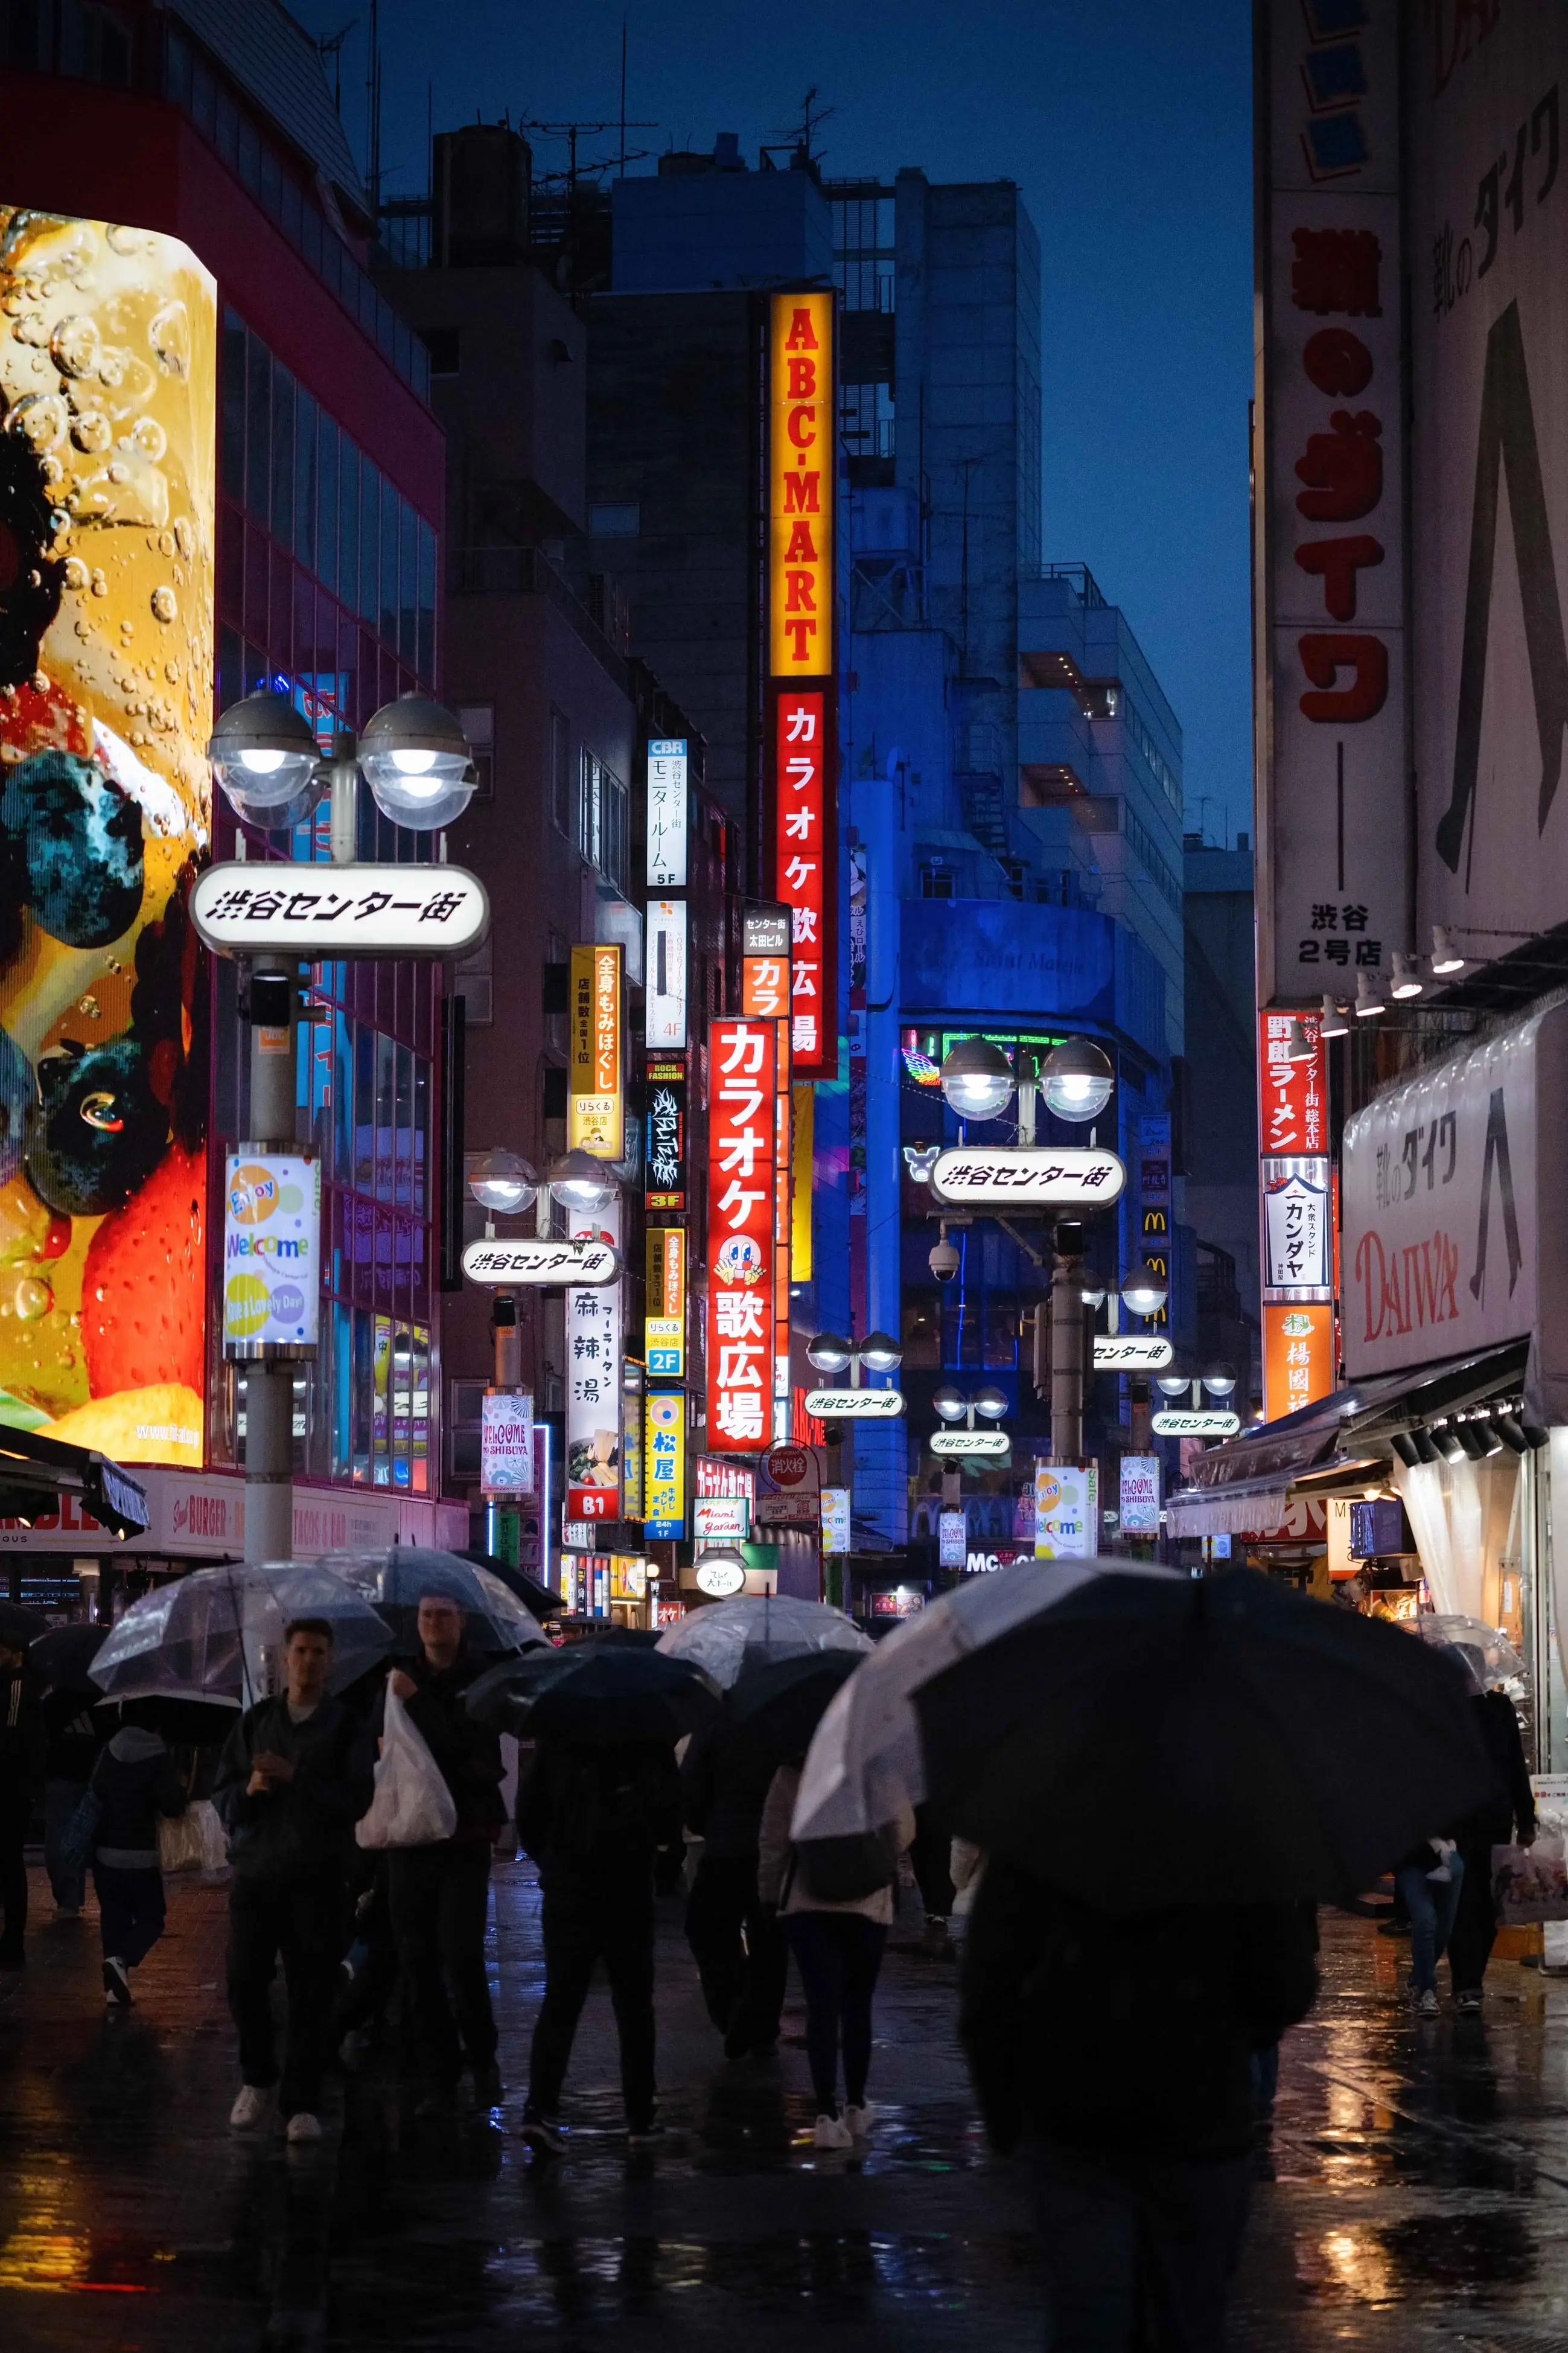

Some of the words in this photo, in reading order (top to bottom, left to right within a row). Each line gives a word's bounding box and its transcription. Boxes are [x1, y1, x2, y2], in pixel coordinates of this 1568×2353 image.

[784, 308, 820, 662] ABC-MART
[651, 741, 683, 755] CBR
[671, 759, 682, 829] 渋谷センター街
[651, 761, 668, 867] モニタールーム
[657, 873, 675, 884] 5F
[205, 890, 467, 922] 渋谷センター街
[747, 919, 785, 930] センター街
[1310, 904, 1369, 931] 渋谷
[749, 935, 783, 947] 太田ビル
[1298, 939, 1382, 966] 2号店
[598, 954, 616, 1090] 全身もみほぐし
[663, 1023, 683, 1036] 4F
[579, 1102, 610, 1111] りらくる
[582, 1116, 608, 1126] 渋谷店
[1376, 1110, 1456, 1210] 靴のダイワ
[942, 1165, 1114, 1187] 渋谷センター街
[650, 1195, 680, 1207] 3F
[1307, 1203, 1316, 1258] 大衆スタンド
[226, 1233, 310, 1259] Welcome
[1286, 1203, 1304, 1278] カンダヤ
[473, 1253, 608, 1270] 渋谷センター街
[668, 1236, 680, 1315] 全身もみほぐし
[1356, 1230, 1459, 1343] DAIWA
[650, 1323, 679, 1332] りらくる
[573, 1292, 600, 1403] 麻辣湯
[602, 1306, 613, 1388] マーラータン
[650, 1338, 679, 1347] 渋谷店
[652, 1353, 677, 1370] 2F
[716, 1291, 765, 1441] 歌広場
[809, 1397, 897, 1409] 渋谷センター街
[1156, 1419, 1237, 1428] 渋谷センター街
[483, 1424, 526, 1445] WELCOME
[934, 1438, 1005, 1448] 渋谷センター街
[490, 1446, 528, 1455] SHIBUYA
[652, 1431, 677, 1481] 松屋
[771, 1457, 805, 1475] 消火栓
[1121, 1478, 1153, 1495] WELCOME
[582, 1496, 604, 1515] B1
[652, 1496, 660, 1516] 定食
[696, 1508, 735, 1519] Miami
[189, 1495, 226, 1537] BURGER
[821, 1515, 847, 1524] elcome
